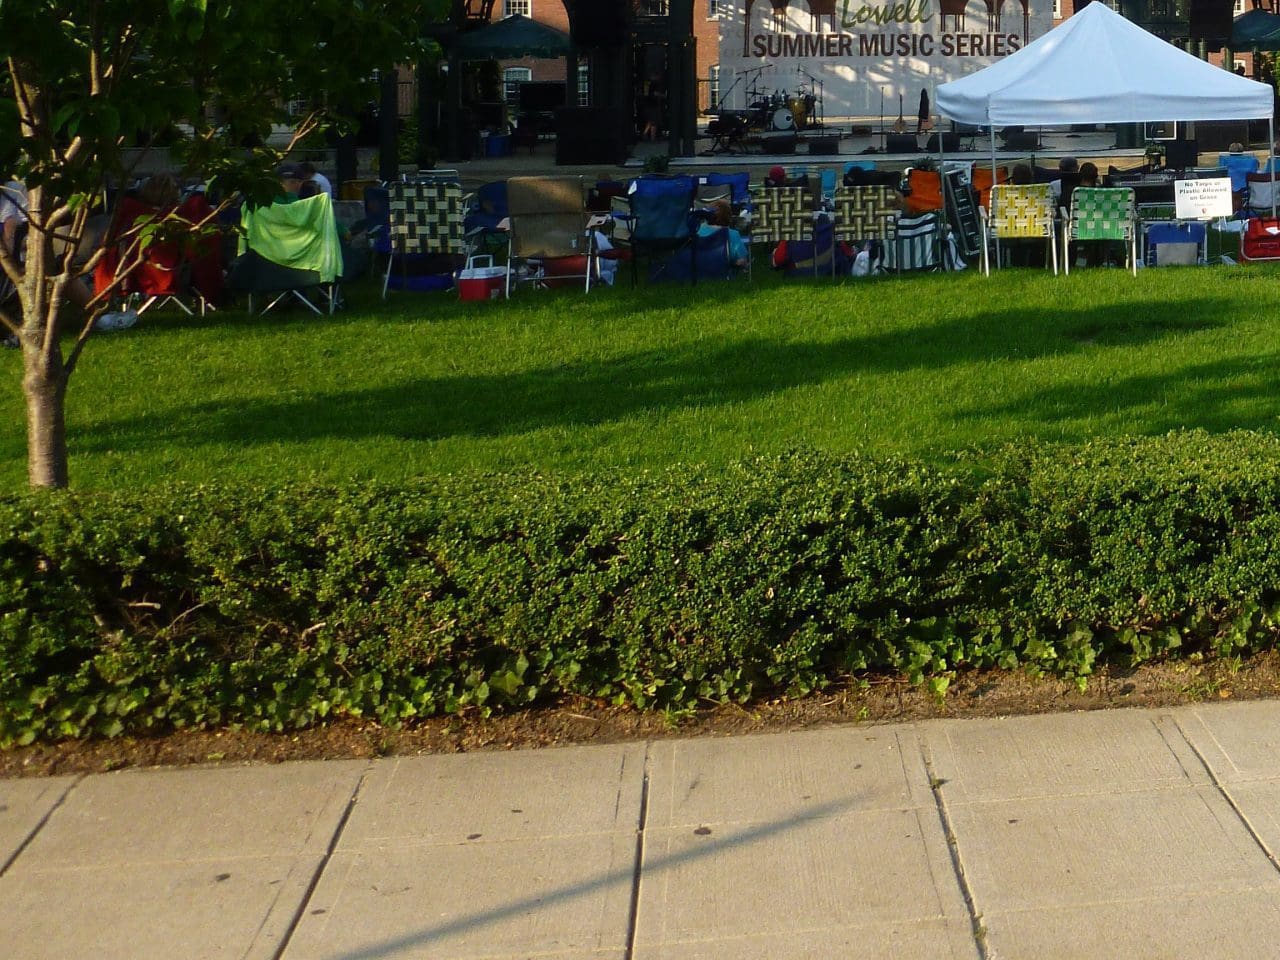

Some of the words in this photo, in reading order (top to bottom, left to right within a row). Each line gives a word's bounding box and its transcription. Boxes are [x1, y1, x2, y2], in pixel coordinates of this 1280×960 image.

[752, 33, 852, 58] SUMMER
[859, 33, 934, 57] MUSIC
[940, 33, 1020, 57] SERIES
